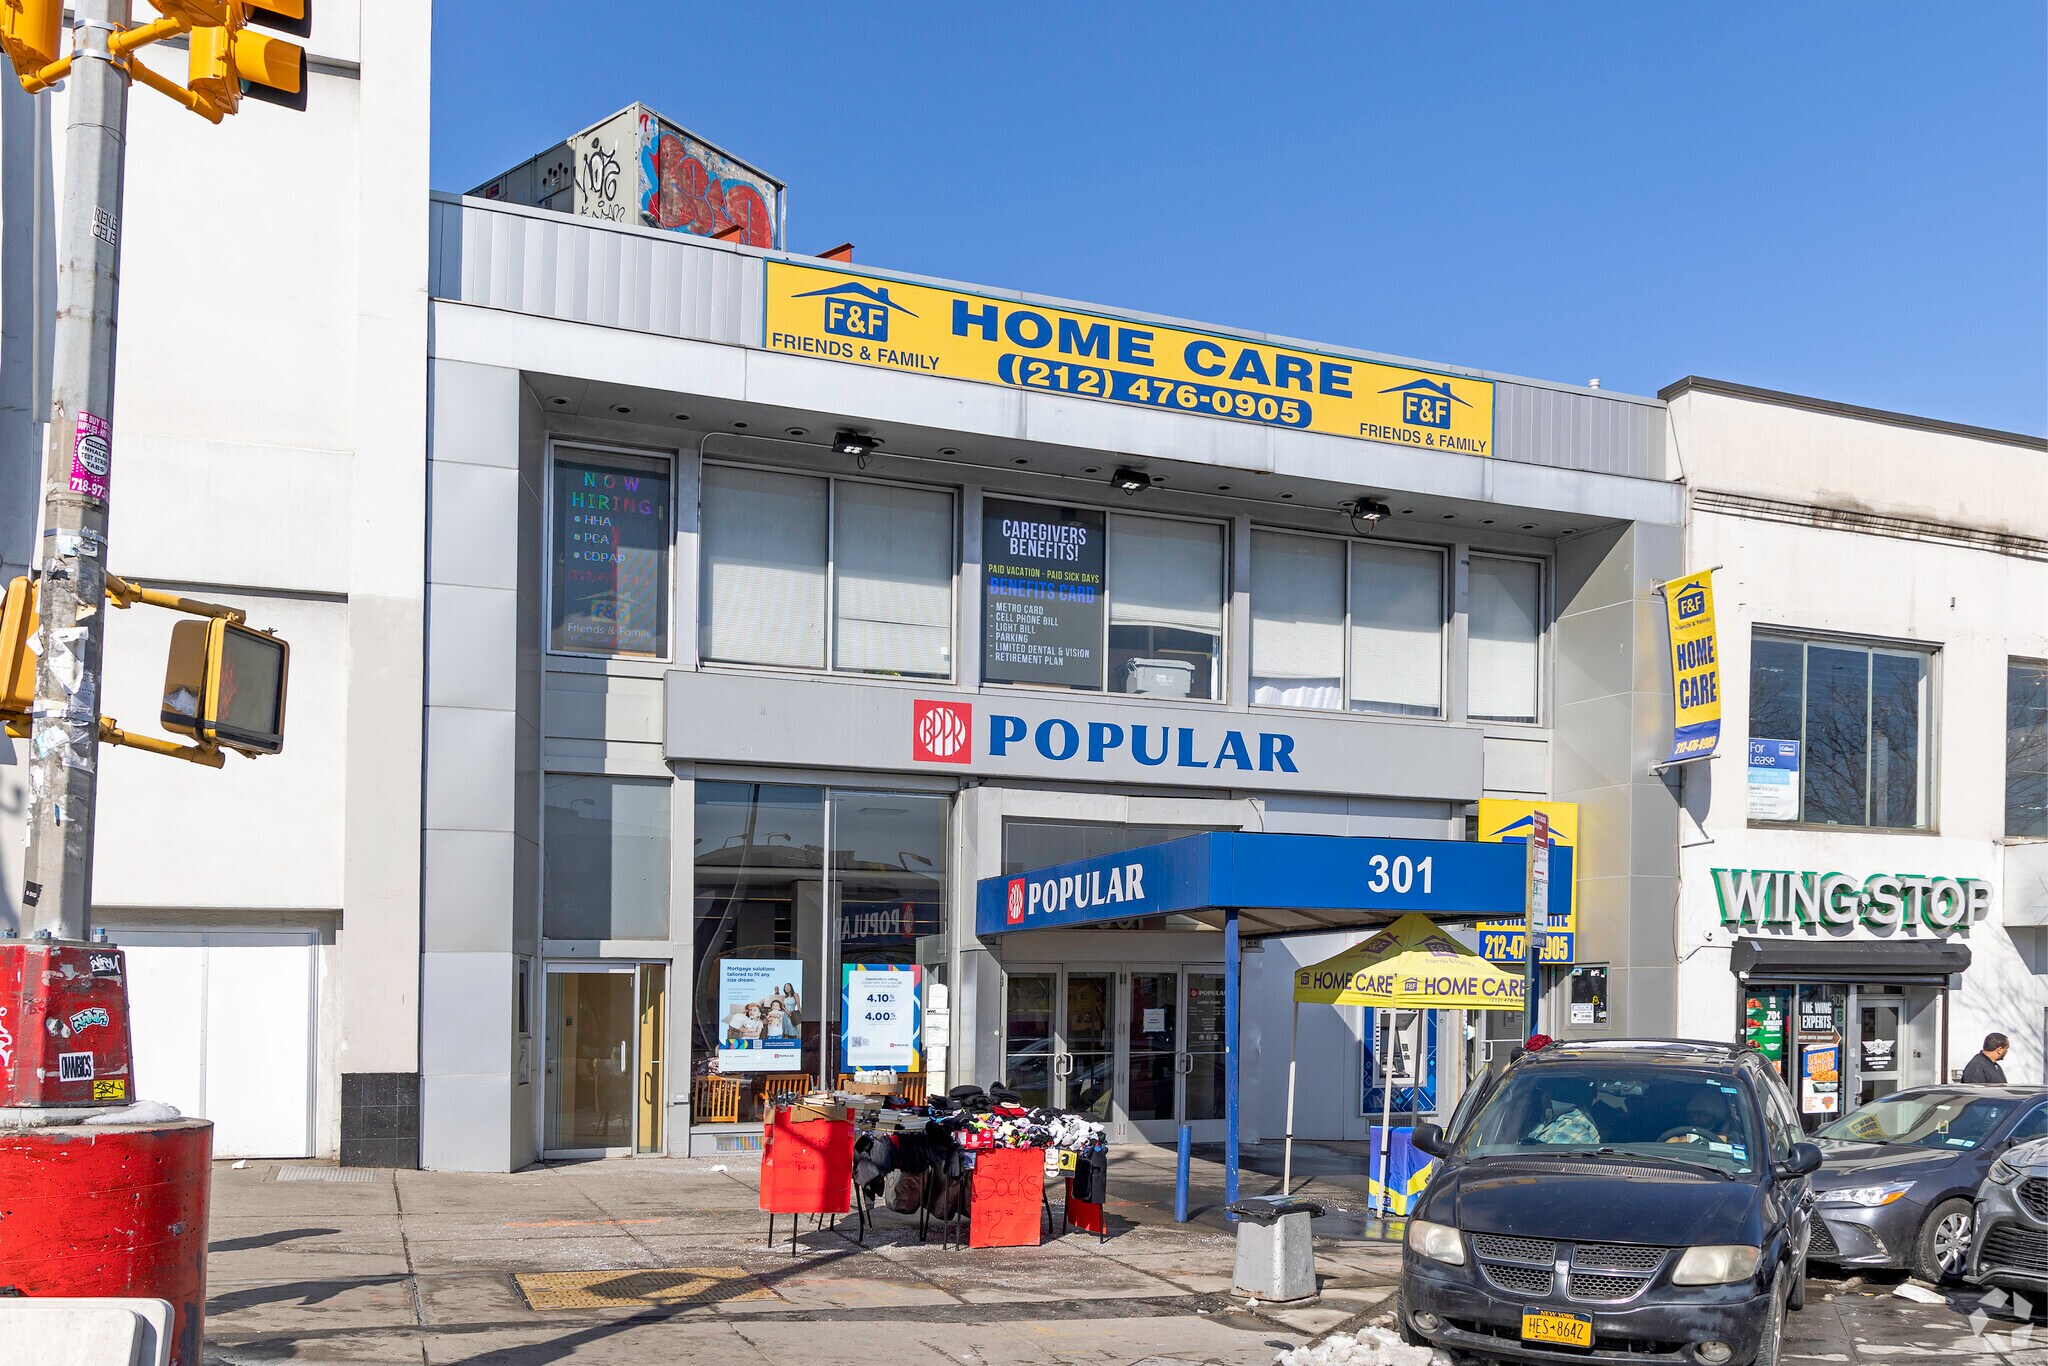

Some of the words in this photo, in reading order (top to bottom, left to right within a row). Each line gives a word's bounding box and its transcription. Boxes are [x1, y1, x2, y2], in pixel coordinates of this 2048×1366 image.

[828, 302, 884, 335] F&F
[772, 332, 853, 358] FRIENDS
[859, 347, 871, 361] &
[878, 349, 940, 370] FAMILY
[952, 299, 1154, 367] HOME
[1184, 340, 1353, 399] CARE
[1012, 355, 1114, 398] (212)
[1128, 378, 1301, 424] 476-0905
[89, 415, 100, 425] BUY
[1406, 396, 1448, 425] F&F
[1360, 422, 1421, 444] FRIENDS
[1426, 434, 1434, 446] &
[1439, 434, 1486, 453] FAMILY
[86, 461, 105, 473] TABS
[584, 471, 640, 492] NOW
[572, 492, 651, 514] HIRING
[584, 515, 611, 527] HHA
[584, 533, 610, 545] PCA
[1002, 519, 1087, 546] CAREGIVERS
[584, 551, 626, 564] CDPAP
[1010, 537, 1079, 561] BENEFITS!
[988, 564, 1005, 575] PAID
[1006, 566, 1040, 578] VACATION
[1046, 569, 1063, 580] PAID
[1064, 571, 1080, 582] SICK
[1081, 573, 1100, 584] DAYS
[990, 576, 1056, 600] BENEFITS
[1059, 582, 1095, 604] CARD
[995, 602, 1022, 613] METRO
[1023, 604, 1044, 615] CARD
[1680, 595, 1702, 616] F&F
[567, 622, 605, 634] Friends
[995, 612, 1014, 622] CELL
[1016, 614, 1041, 624] PHONE
[1043, 616, 1059, 626] BILL
[995, 623, 1017, 633] LIGHT
[1019, 624, 1036, 634] BILL
[995, 633, 1028, 643] PARKING
[995, 643, 1026, 653] LIMITED
[1028, 645, 1056, 656] DENTAL
[1065, 648, 1090, 658] VISION
[995, 652, 1042, 664] RETIREMENT
[1045, 655, 1064, 666] PLAN
[1676, 635, 1714, 671] HOME
[1680, 671, 1717, 710] CARE
[988, 714, 1299, 774] POPULAR
[1750, 741, 1765, 753] For
[1750, 753, 1775, 766] Lease
[1367, 854, 1433, 894] 301
[1027, 863, 1146, 916] POPULAR
[1313, 971, 1352, 990] HOME
[1355, 973, 1394, 994] CARE
[1424, 976, 1478, 995] HOME
[1802, 1001, 1813, 1014] THE
[1814, 1001, 1832, 1014] WING
[1802, 1015, 1832, 1029] EXPERTS
[1807, 1050, 1835, 1064] LEMON
[976, 1164, 1041, 1201] Socks
